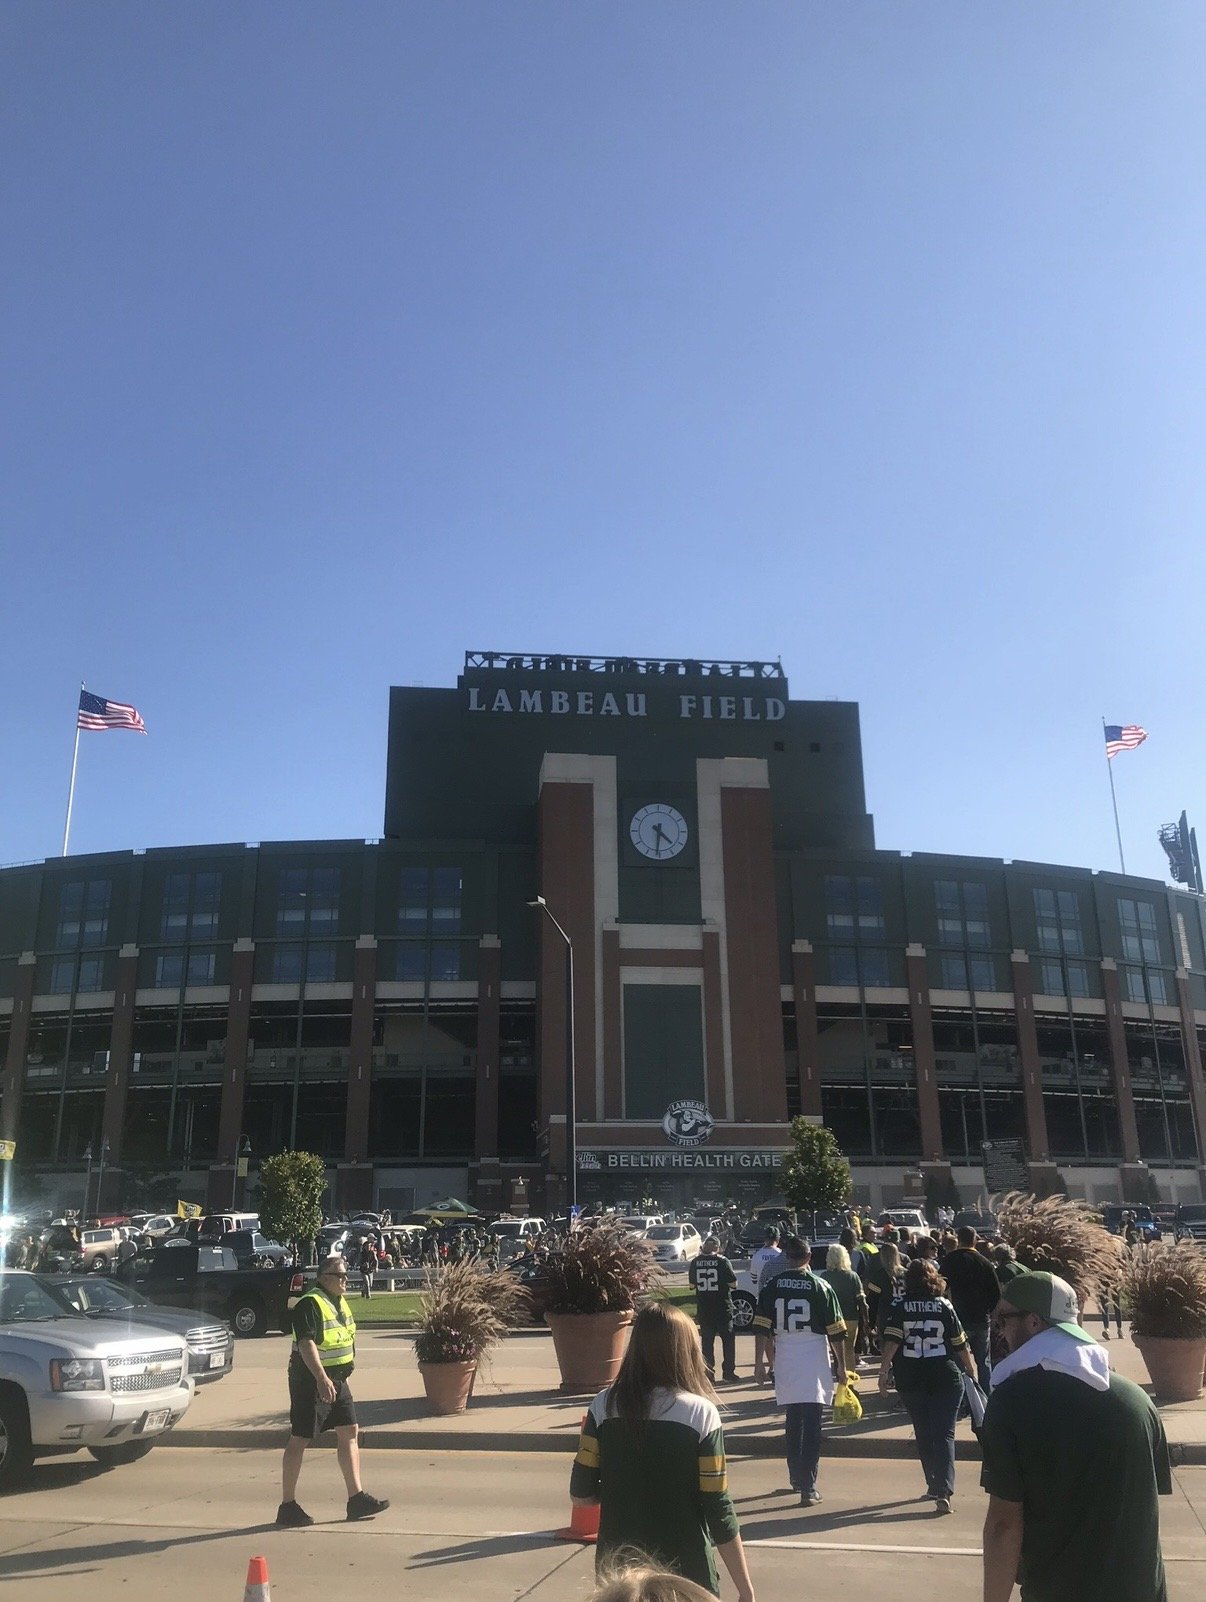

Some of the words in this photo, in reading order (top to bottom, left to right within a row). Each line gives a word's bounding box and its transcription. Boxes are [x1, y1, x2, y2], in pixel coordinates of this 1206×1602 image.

[468, 687, 648, 717] LAMBEAU
[679, 694, 786, 721] FIELD
[671, 1101, 705, 1112] LAMBEAU
[678, 1138, 700, 1146] FIELD
[608, 1154, 665, 1167] BELLIN
[671, 1154, 734, 1167] HEALTH
[740, 1154, 782, 1167] GATE
[695, 1268, 719, 1291] 52
[776, 1278, 812, 1290] RODGERS
[773, 1297, 812, 1333] 12
[902, 1319, 947, 1359] 52
